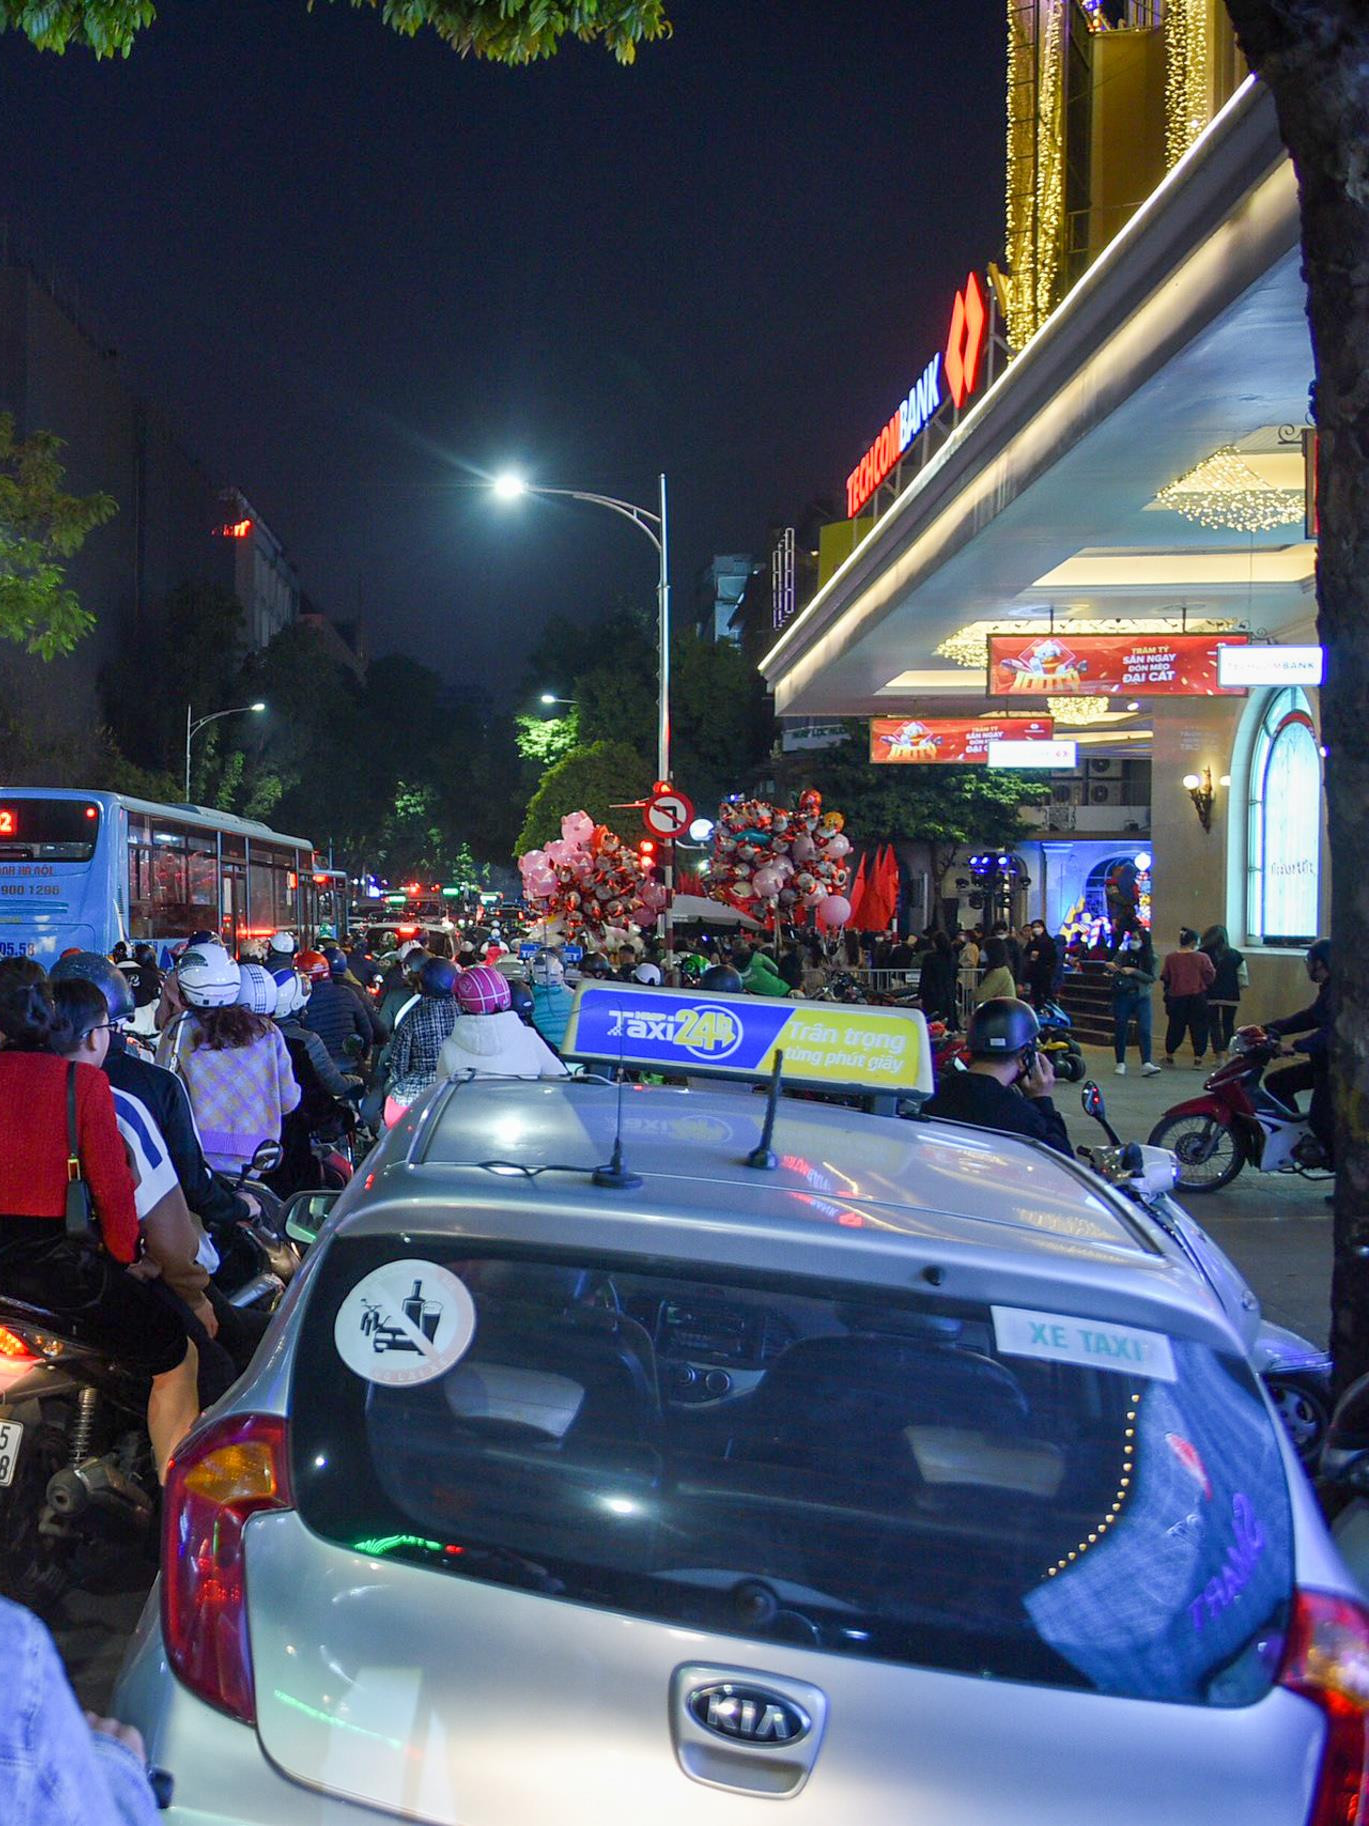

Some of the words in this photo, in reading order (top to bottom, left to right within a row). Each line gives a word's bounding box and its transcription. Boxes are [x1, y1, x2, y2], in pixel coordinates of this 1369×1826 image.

[846, 352, 943, 519] TECHCOMBANK
[1147, 654, 1176, 663] NGAY
[845, 1027, 907, 1055] trọng
[825, 1050, 866, 1067] phút
[1028, 1321, 1069, 1349] XE
[1077, 1329, 1145, 1361] TAXI
[707, 1693, 789, 1738] KIA
